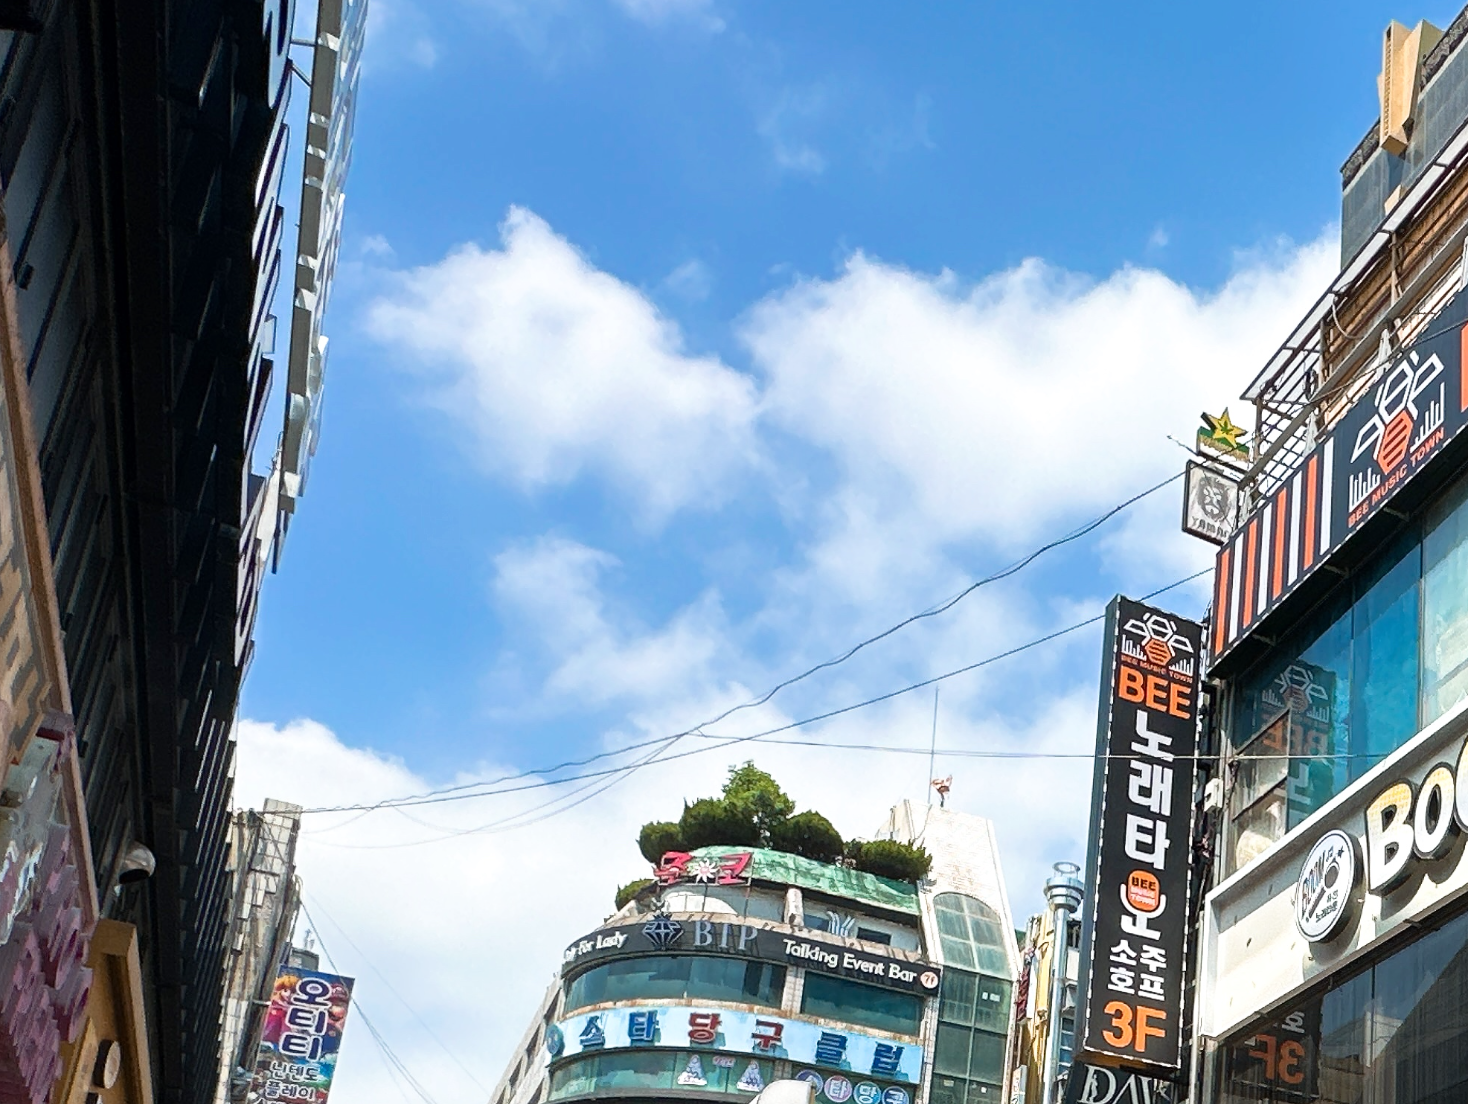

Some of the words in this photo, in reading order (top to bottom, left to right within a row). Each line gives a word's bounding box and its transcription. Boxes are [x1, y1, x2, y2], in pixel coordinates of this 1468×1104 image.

[1347, 500, 1369, 528] BEE
[1371, 463, 1408, 506] MUSIC
[1410, 426, 1444, 467] TOWN
[1118, 664, 1192, 720] BEE
[782, 938, 838, 968] Talking
[843, 952, 885, 976] Event
[888, 963, 917, 982] Bar
[1109, 939, 1167, 973] 소주
[1107, 966, 1165, 1001] 호프
[280, 978, 332, 1062] 오티티
[1102, 999, 1167, 1052] 3F
[265, 1080, 316, 1100] 플레이
[271, 1062, 320, 1081] 닌텐도
